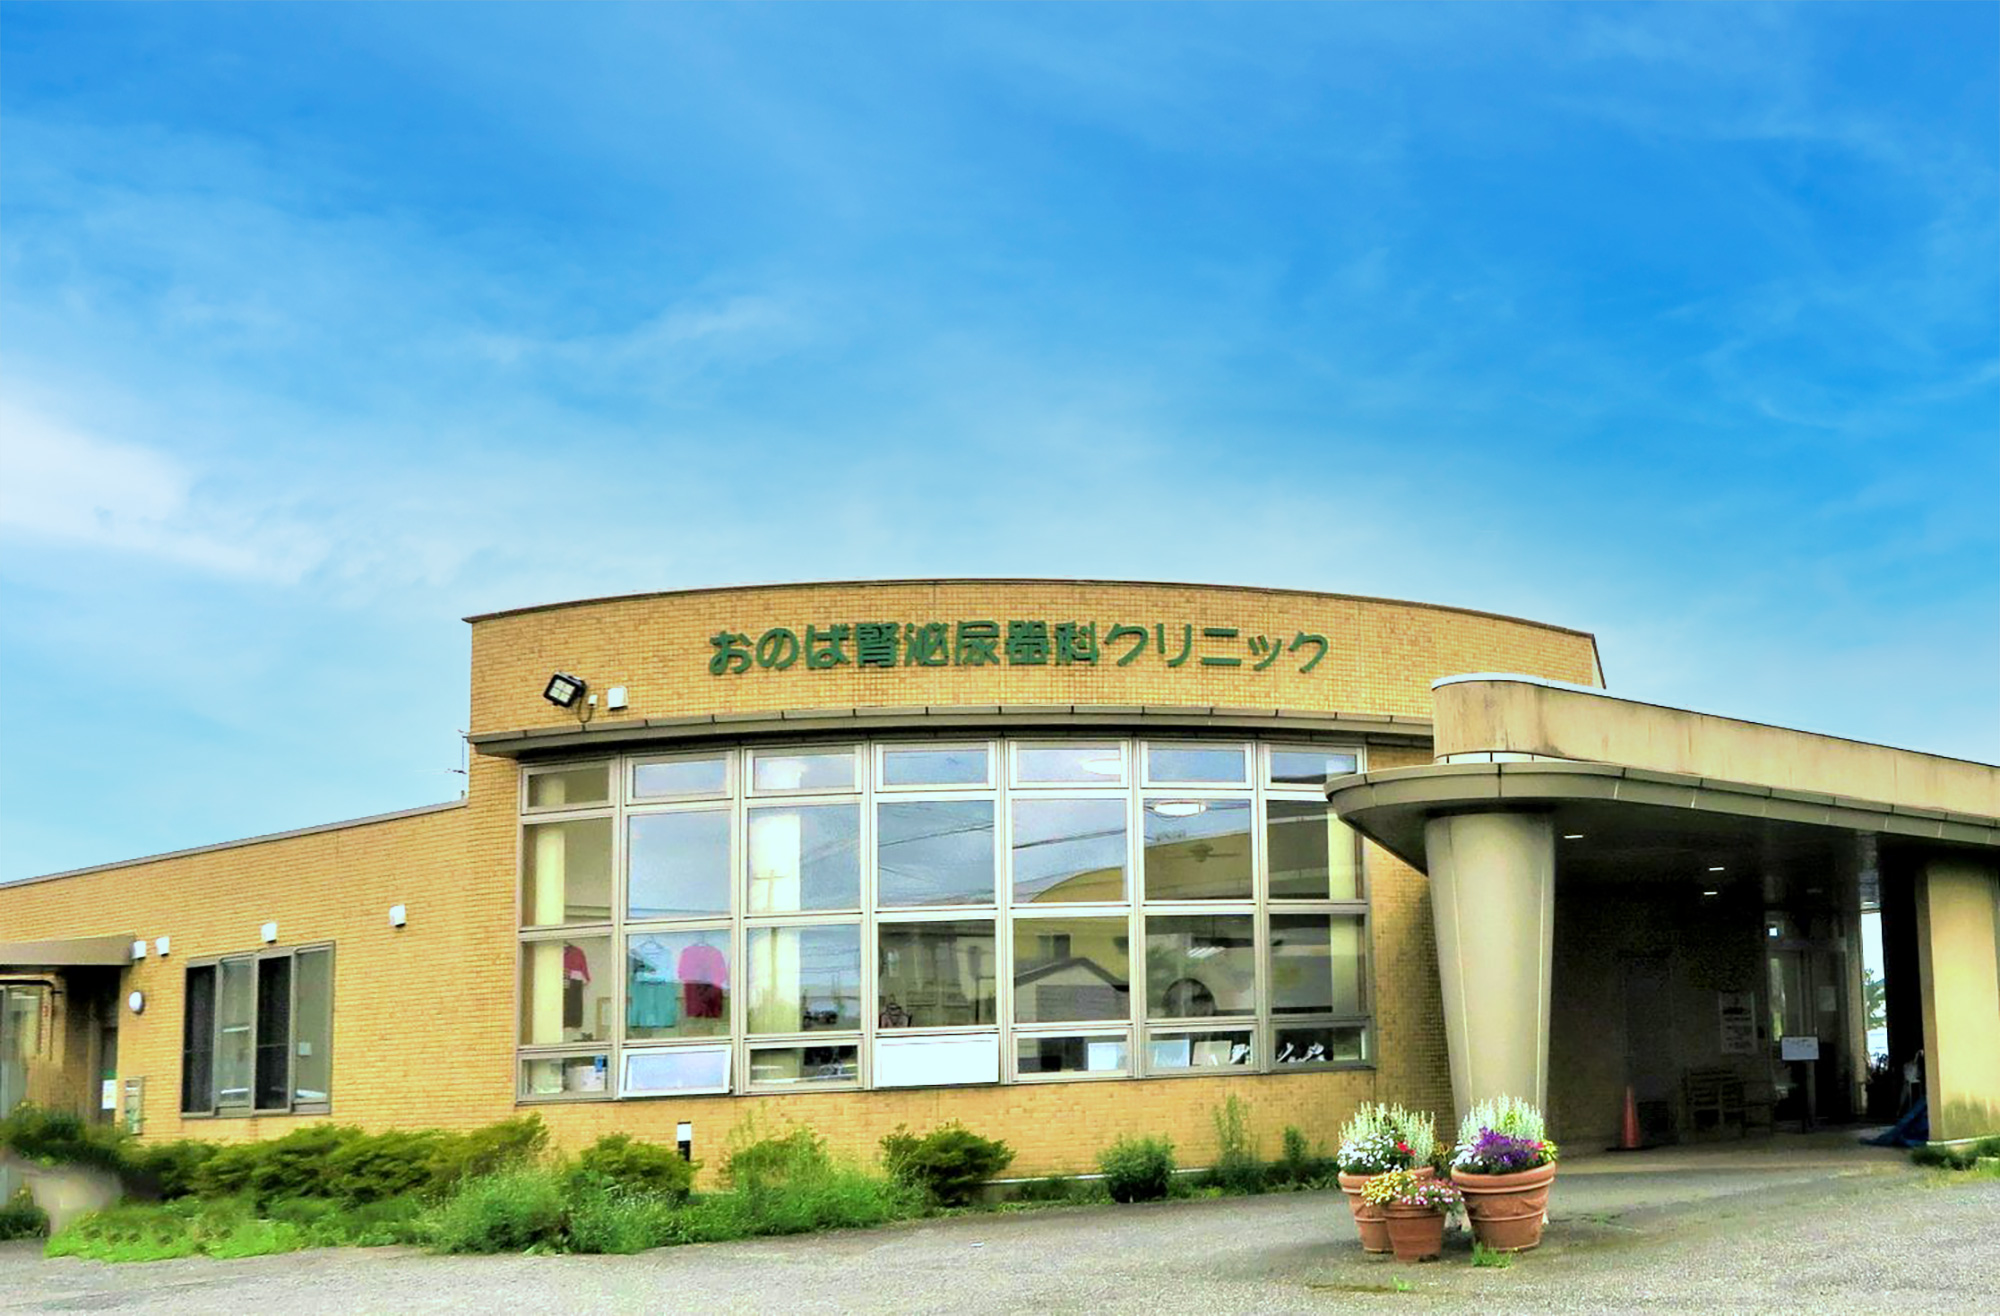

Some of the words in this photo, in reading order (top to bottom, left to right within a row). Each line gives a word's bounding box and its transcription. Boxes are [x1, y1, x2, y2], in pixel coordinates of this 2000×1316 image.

[709, 620, 1329, 675] おのば腎泌尿器科クリニック
